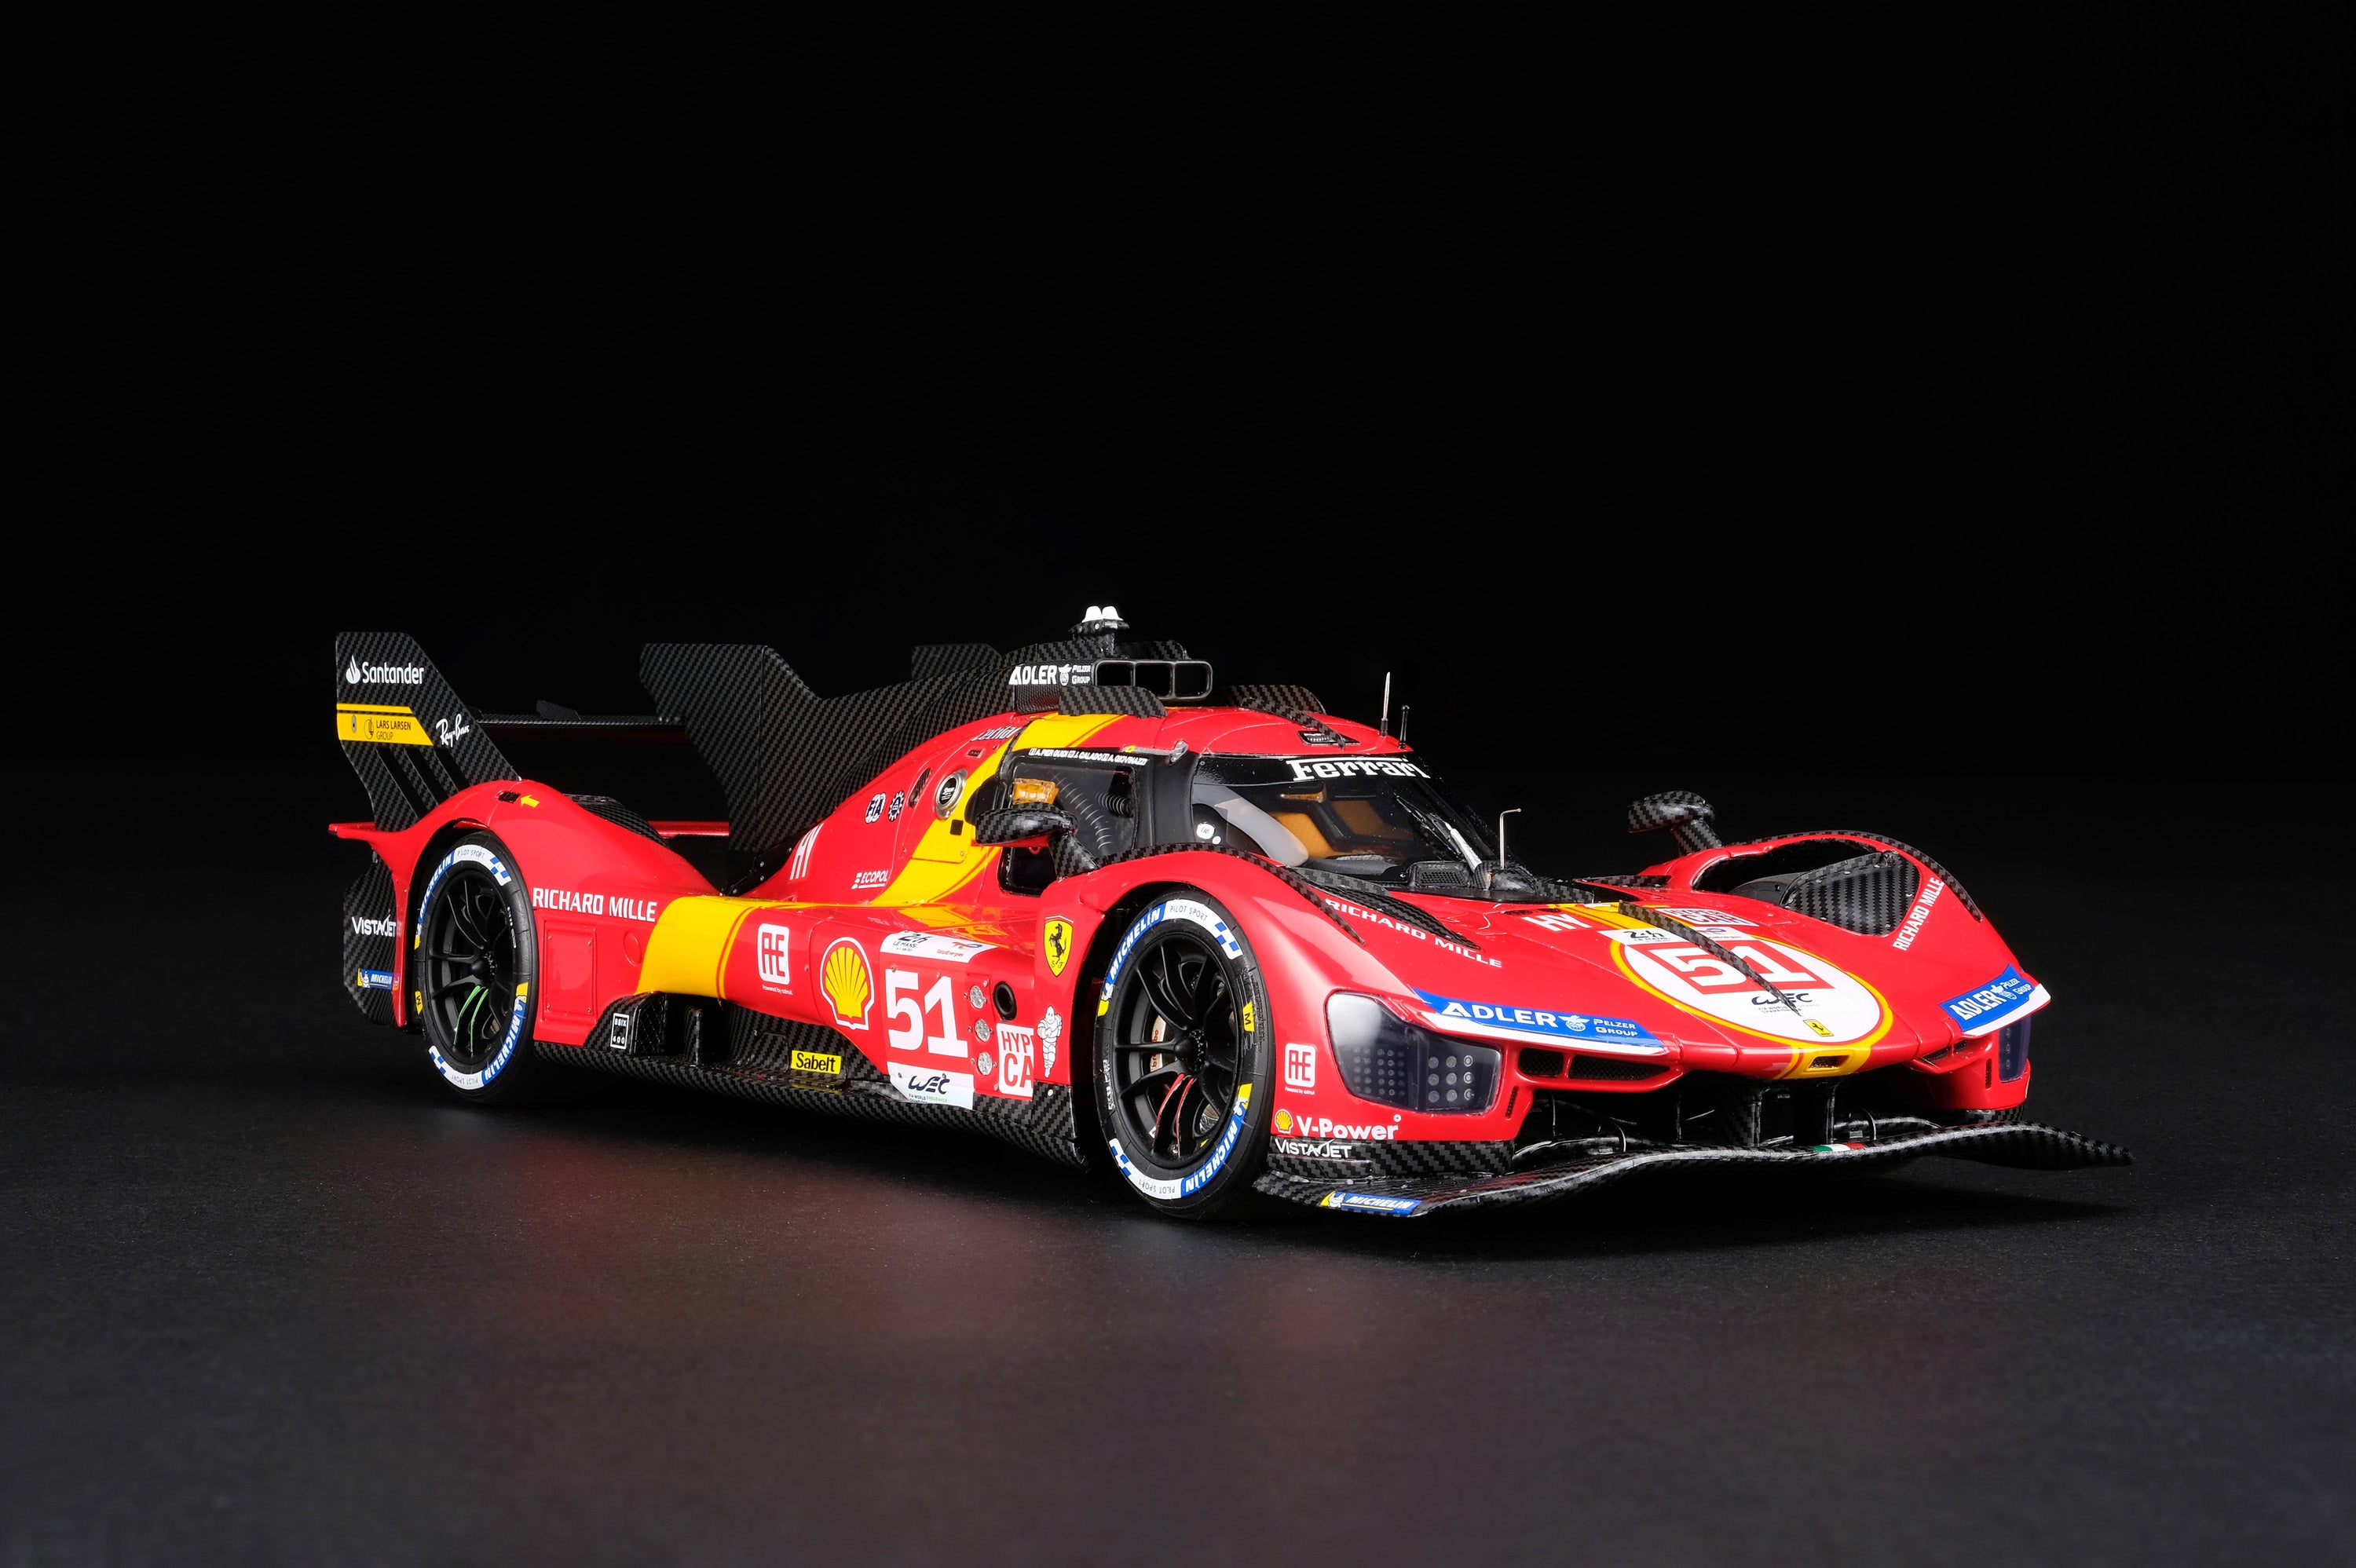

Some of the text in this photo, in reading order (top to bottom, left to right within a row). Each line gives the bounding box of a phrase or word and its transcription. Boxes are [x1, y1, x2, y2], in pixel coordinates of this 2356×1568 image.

[362, 661, 424, 684] Santander
[1008, 665, 1057, 685] ADLER
[1071, 674, 1091, 685] GROUP
[376, 719, 412, 730] LARS LARSEN
[376, 731, 393, 740] GROUP
[1286, 757, 1431, 781] Ferrari
[860, 870, 888, 884] ECOPOL
[532, 887, 657, 923] RICHARD MILLE
[1169, 905, 1208, 922] PILOT SPORT
[1892, 877, 1945, 951] RICHARD MILLE
[351, 914, 397, 938] VISTAJET
[1325, 898, 1502, 968] RICHARD MILLE
[1521, 913, 1593, 932] HY
[1110, 907, 1162, 981] MICHELIN
[1648, 945, 1817, 986] 51
[1751, 993, 1813, 1005] WEC
[2012, 983, 2032, 995] GROUP
[885, 967, 968, 1058] 51
[1441, 1001, 1559, 1028] ADLER
[1949, 990, 2007, 1021] ADLER
[1245, 1012, 1252, 1025] M
[1593, 1018, 1636, 1029] PELZER
[1001, 1030, 1033, 1054] HYP
[1595, 1026, 1638, 1037] GROUP
[484, 1014, 521, 1080] MICHELIN
[796, 1051, 836, 1073] Sabelt
[1004, 1053, 1034, 1089] CA
[908, 1075, 950, 1095] WEC
[1296, 1116, 1399, 1140] V-Power
[1184, 1120, 1238, 1193] MICHELIN
[1275, 1139, 1352, 1158] VISTAJET
[1137, 1179, 1176, 1194] PILOT SPORT
[1348, 1194, 1414, 1210] MICHELIN
